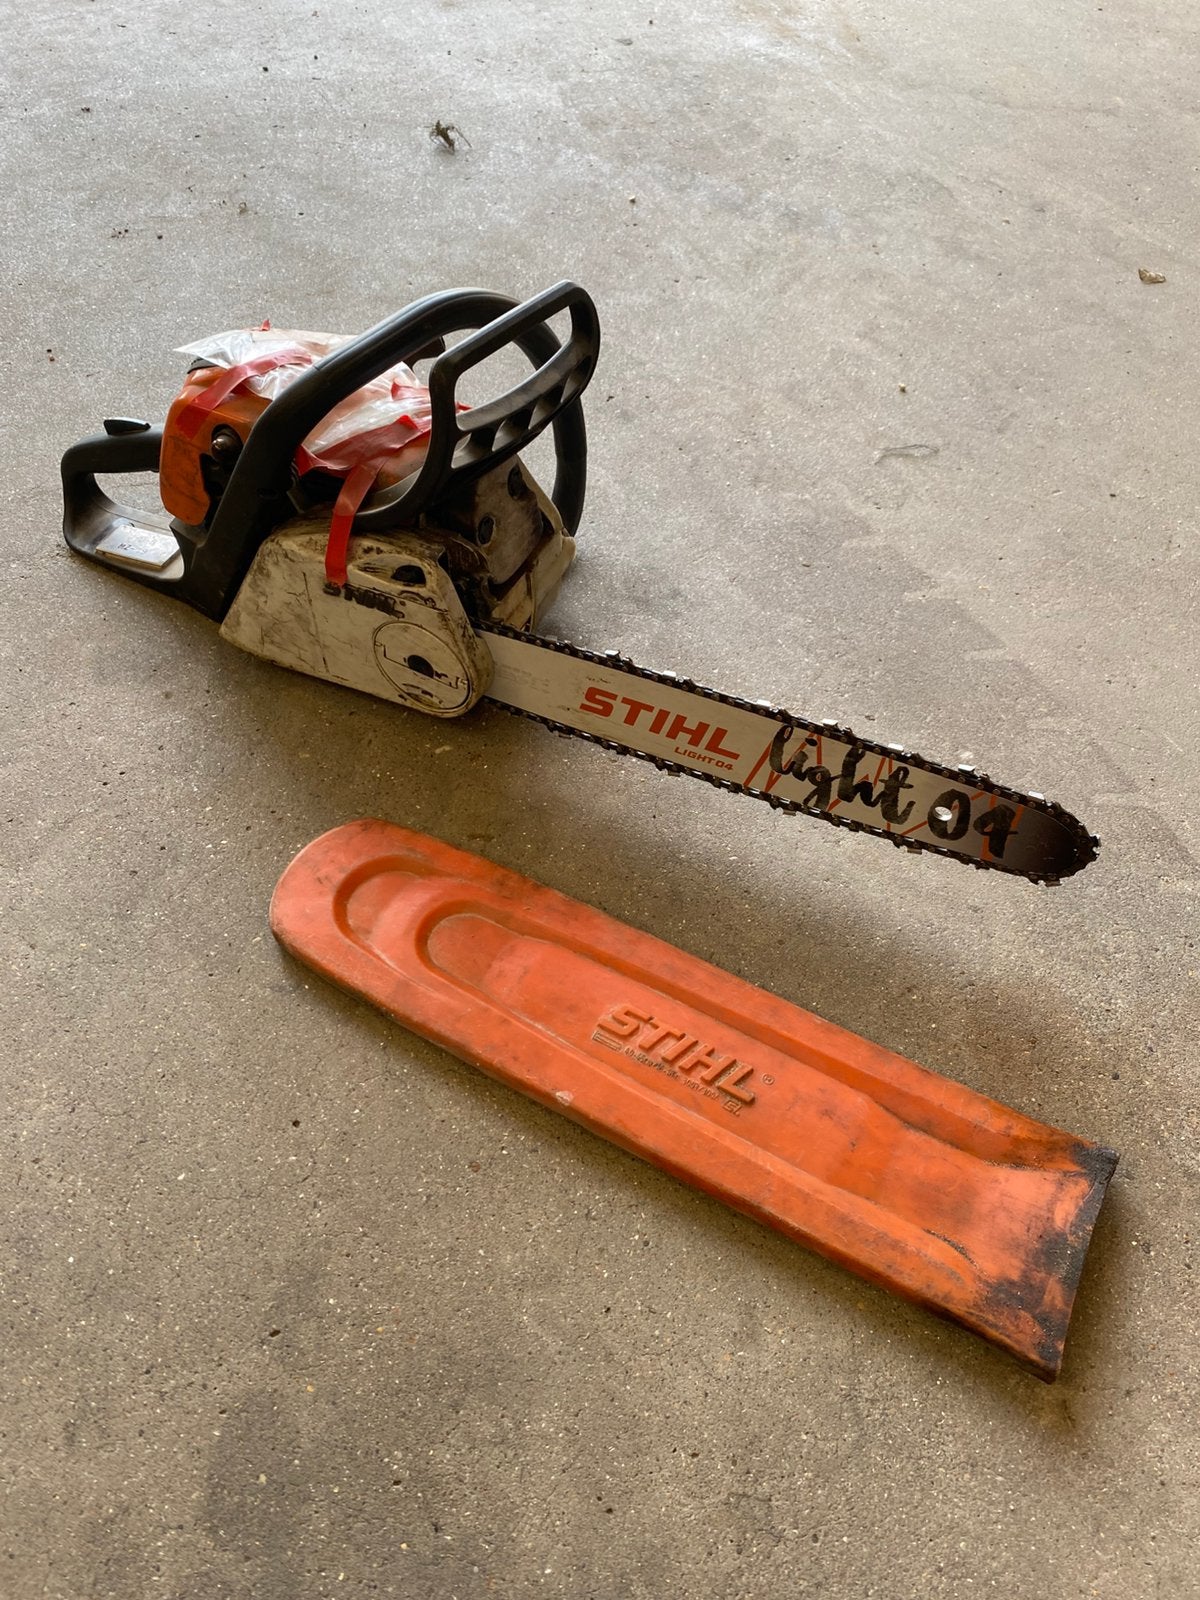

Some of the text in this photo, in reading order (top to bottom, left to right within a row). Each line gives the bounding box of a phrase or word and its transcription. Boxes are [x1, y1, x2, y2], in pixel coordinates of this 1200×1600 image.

[579, 686, 740, 760] STIHL
[769, 724, 1018, 859] light 04
[597, 1003, 755, 1105] STIHL
